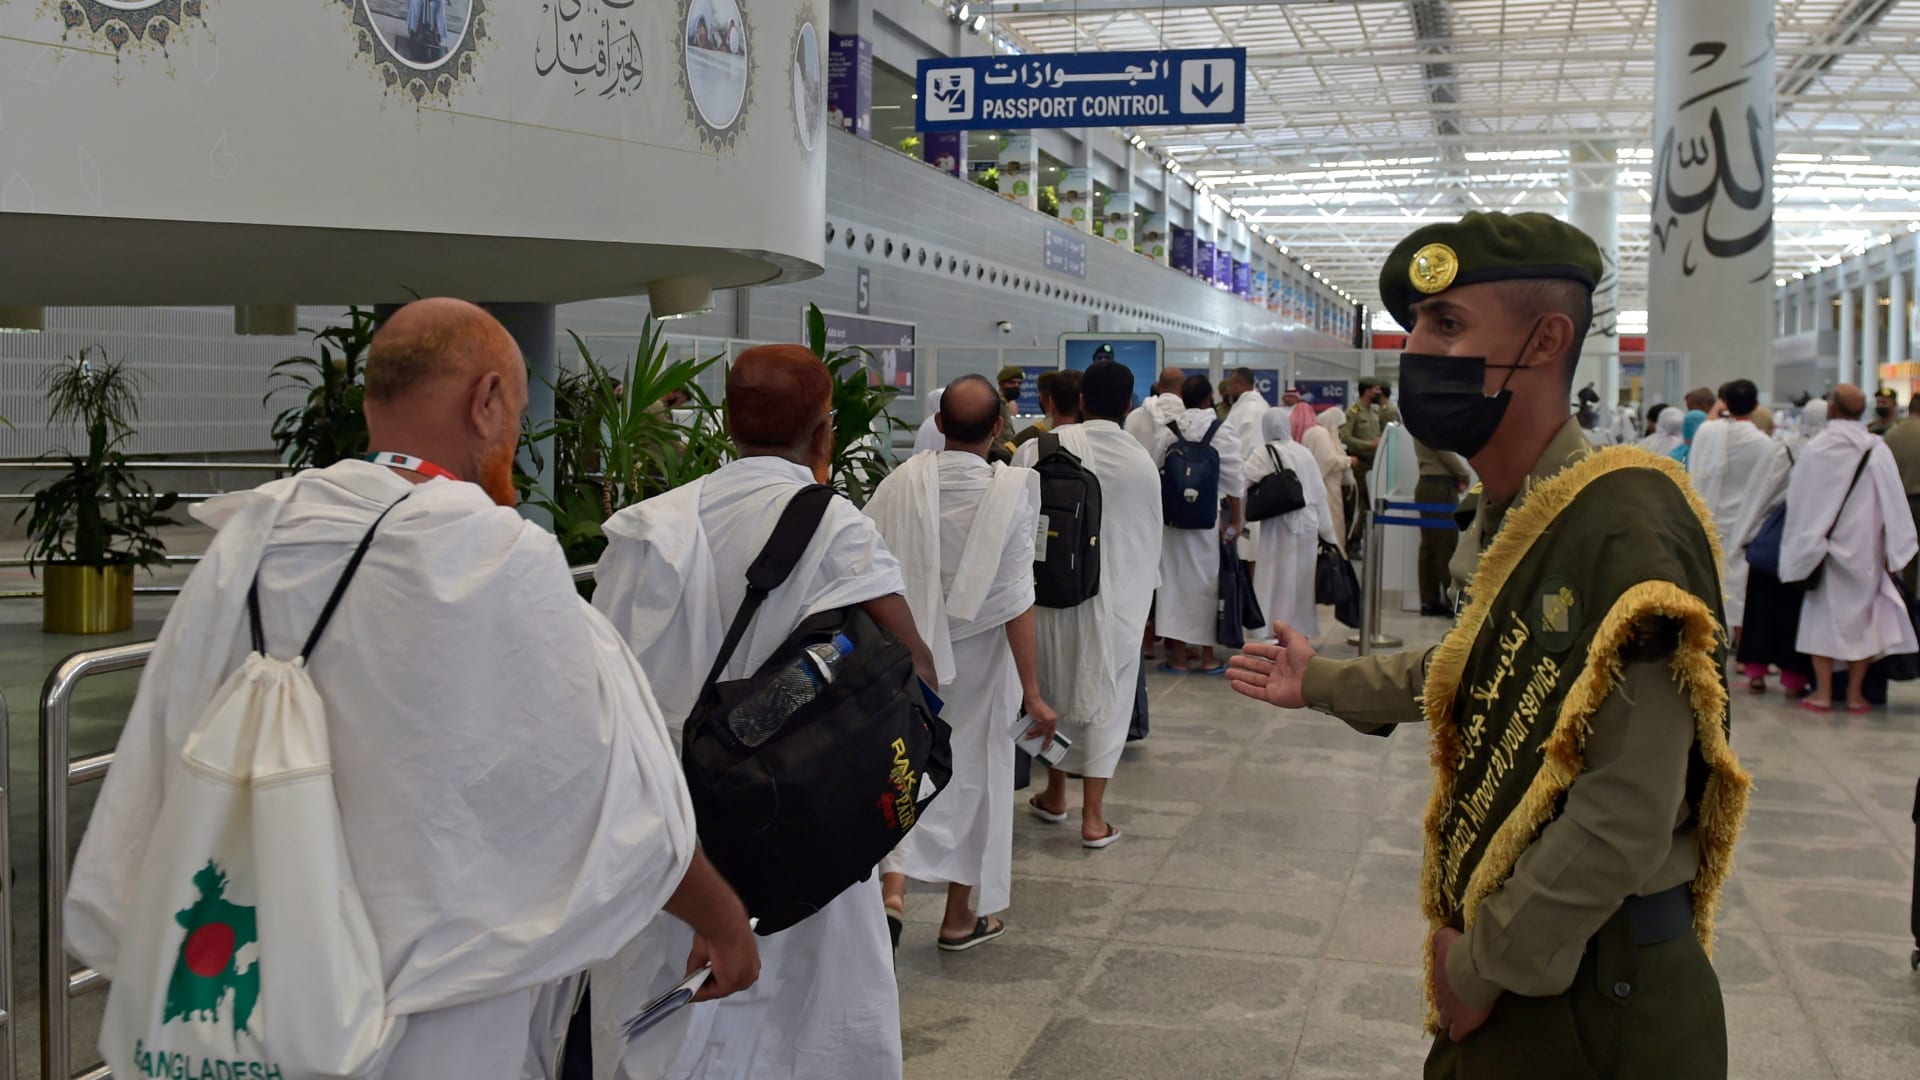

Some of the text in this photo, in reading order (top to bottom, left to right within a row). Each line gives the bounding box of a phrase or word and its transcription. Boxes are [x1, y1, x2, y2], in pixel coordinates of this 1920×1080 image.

[984, 58, 1169, 88] الجوازات
[982, 94, 1169, 120] PASSPORT CONTROL
[859, 274, 868, 309] 5
[1322, 384, 1344, 397] stc
[1490, 743, 1509, 779] at
[1500, 710, 1530, 770] your
[1518, 656, 1561, 725] service
